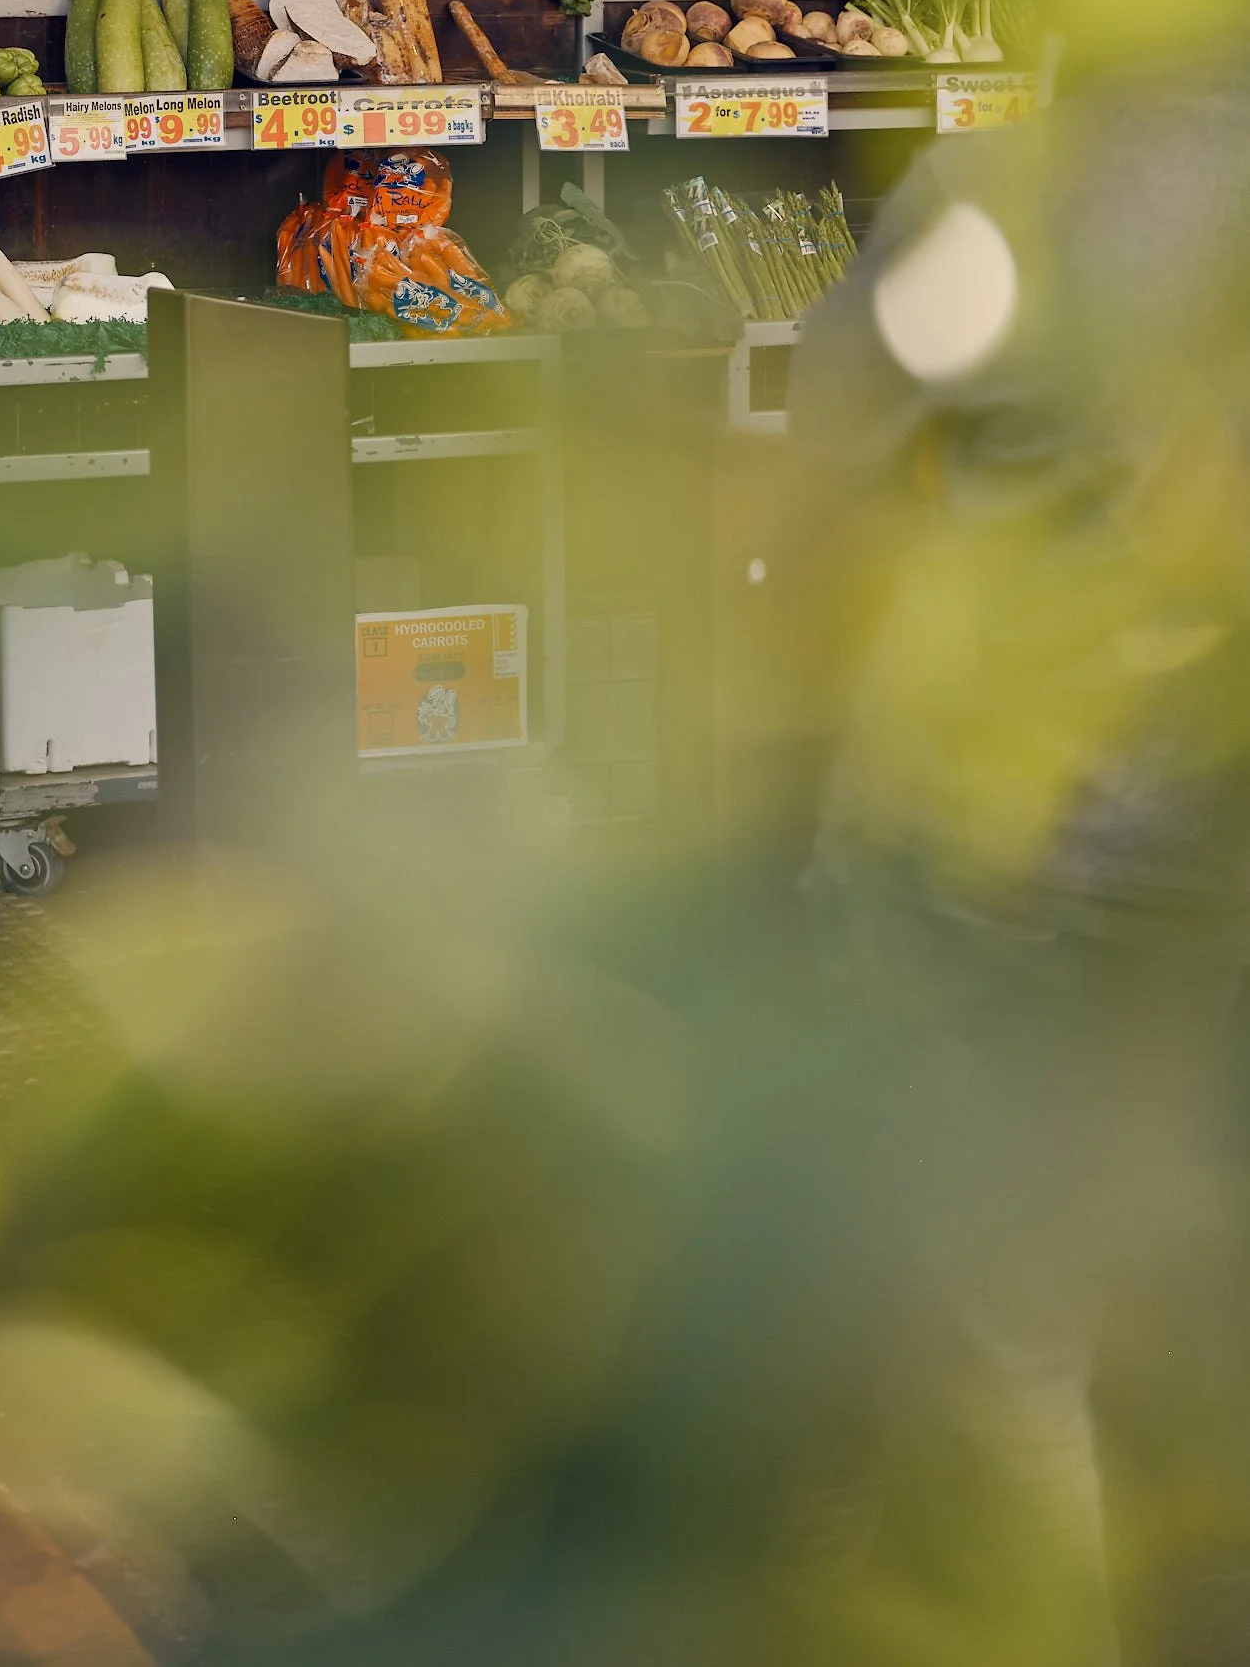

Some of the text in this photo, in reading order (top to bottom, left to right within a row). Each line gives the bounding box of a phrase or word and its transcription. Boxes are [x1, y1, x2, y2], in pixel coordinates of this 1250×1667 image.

[258, 90, 337, 107] Beetroot
[553, 90, 621, 106] Kholrabi
[694, 85, 806, 100] Asparagus
[66, 101, 122, 114] Hairy Melons
[124, 102, 155, 117] Melon
[156, 97, 221, 114] Long Melon
[353, 95, 474, 112] Carrots
[2, 105, 41, 126] Radish
[688, 102, 712, 133] 2
[715, 106, 731, 118] for
[953, 98, 976, 127] 3
[113, 135, 123, 146] kg
[609, 140, 626, 148] each
[31, 154, 47, 164] kg
[394, 619, 485, 635] HYDROCOOLED
[412, 635, 469, 648] CARROTS
